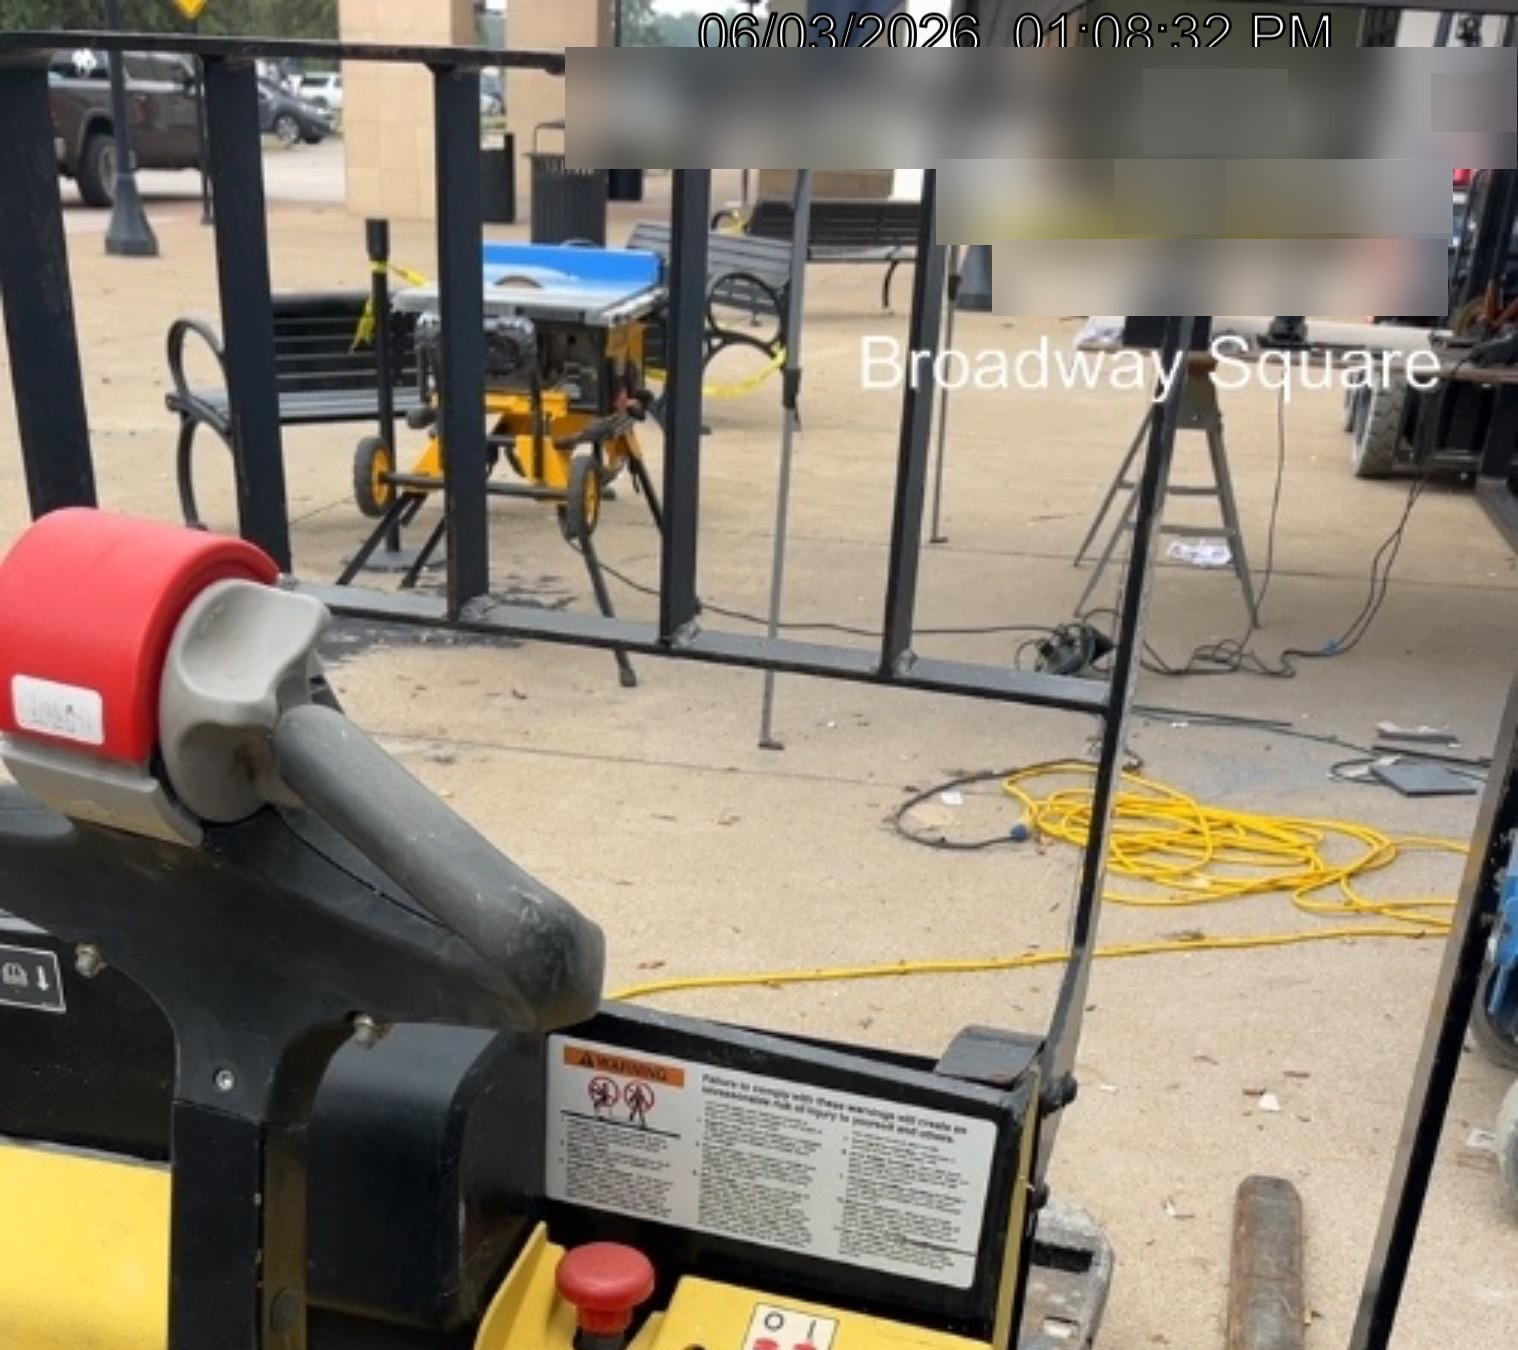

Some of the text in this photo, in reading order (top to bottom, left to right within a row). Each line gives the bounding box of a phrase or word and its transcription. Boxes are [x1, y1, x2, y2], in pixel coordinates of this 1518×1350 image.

[597, 1055, 668, 1081] WARNING
[702, 1074, 738, 1089] Failure
[752, 1085, 790, 1100] comply
[790, 1093, 813, 1105] with
[815, 1096, 844, 1111] these
[847, 1104, 895, 1121] warnings
[918, 1119, 952, 1132] create
